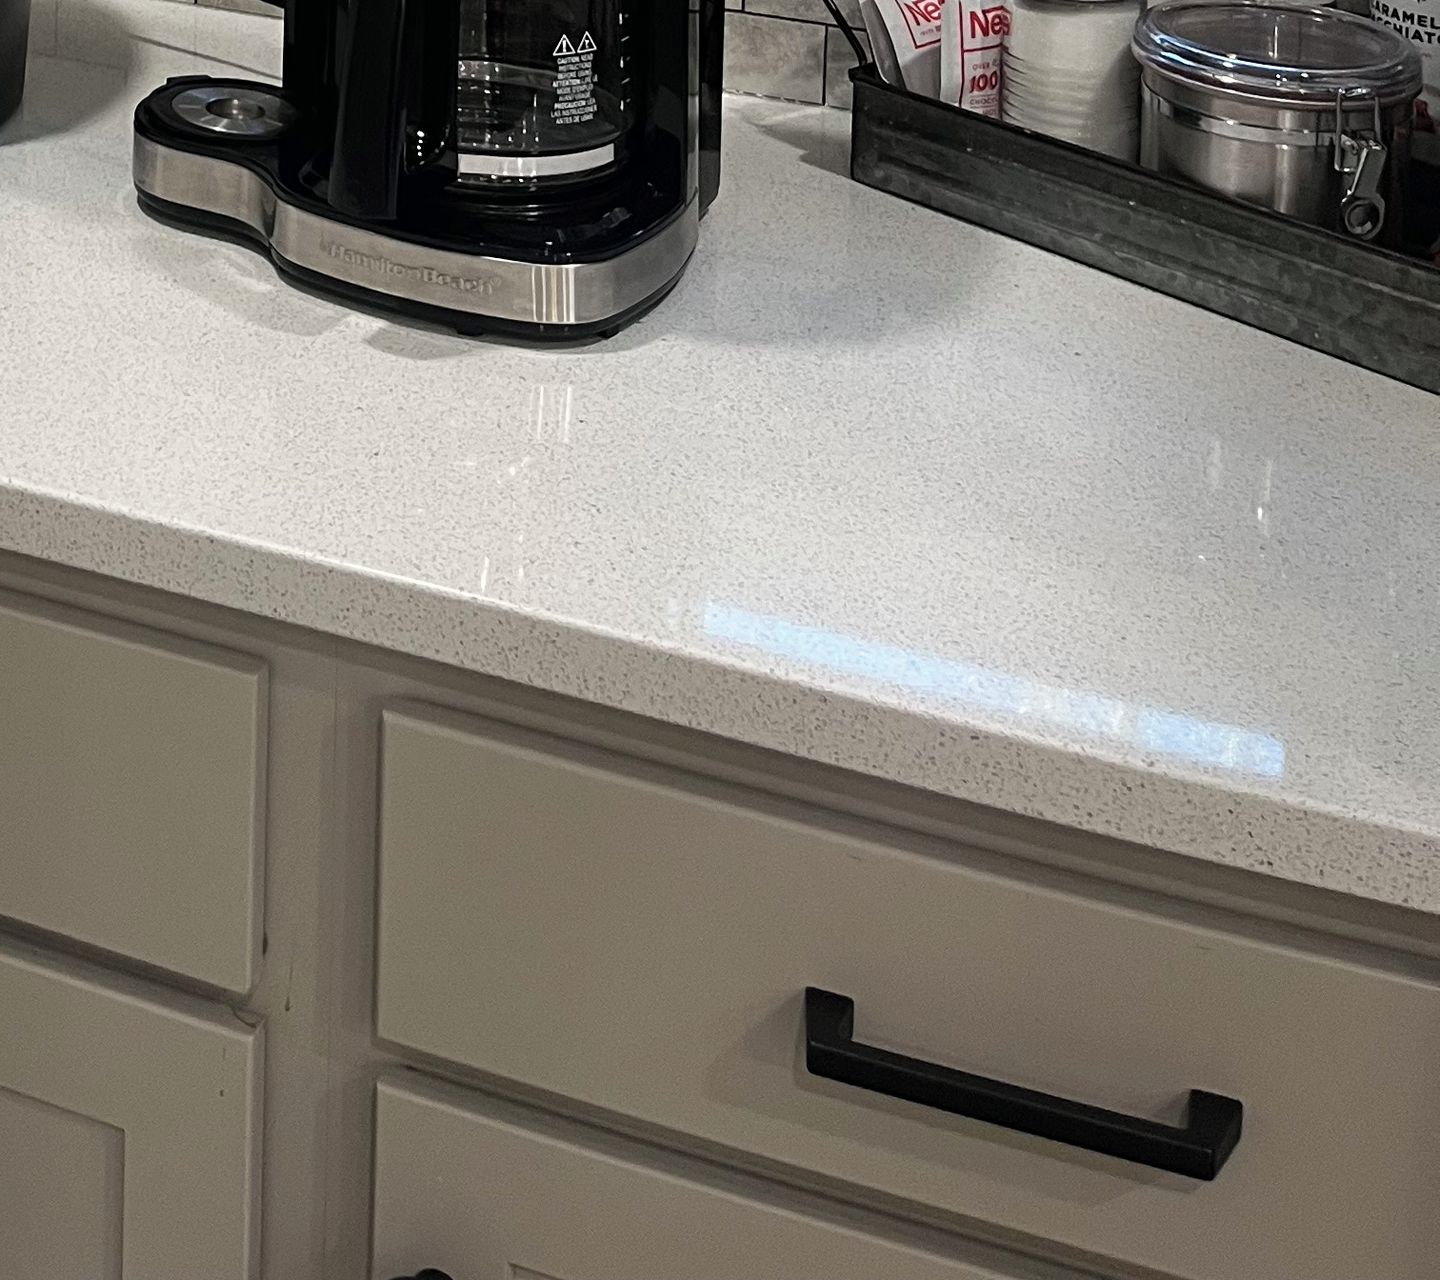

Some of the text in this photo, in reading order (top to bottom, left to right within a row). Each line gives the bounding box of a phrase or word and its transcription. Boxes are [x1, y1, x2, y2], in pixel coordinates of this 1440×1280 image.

[969, 71, 998, 93] 100
[329, 244, 492, 295] Hamilton Beach
